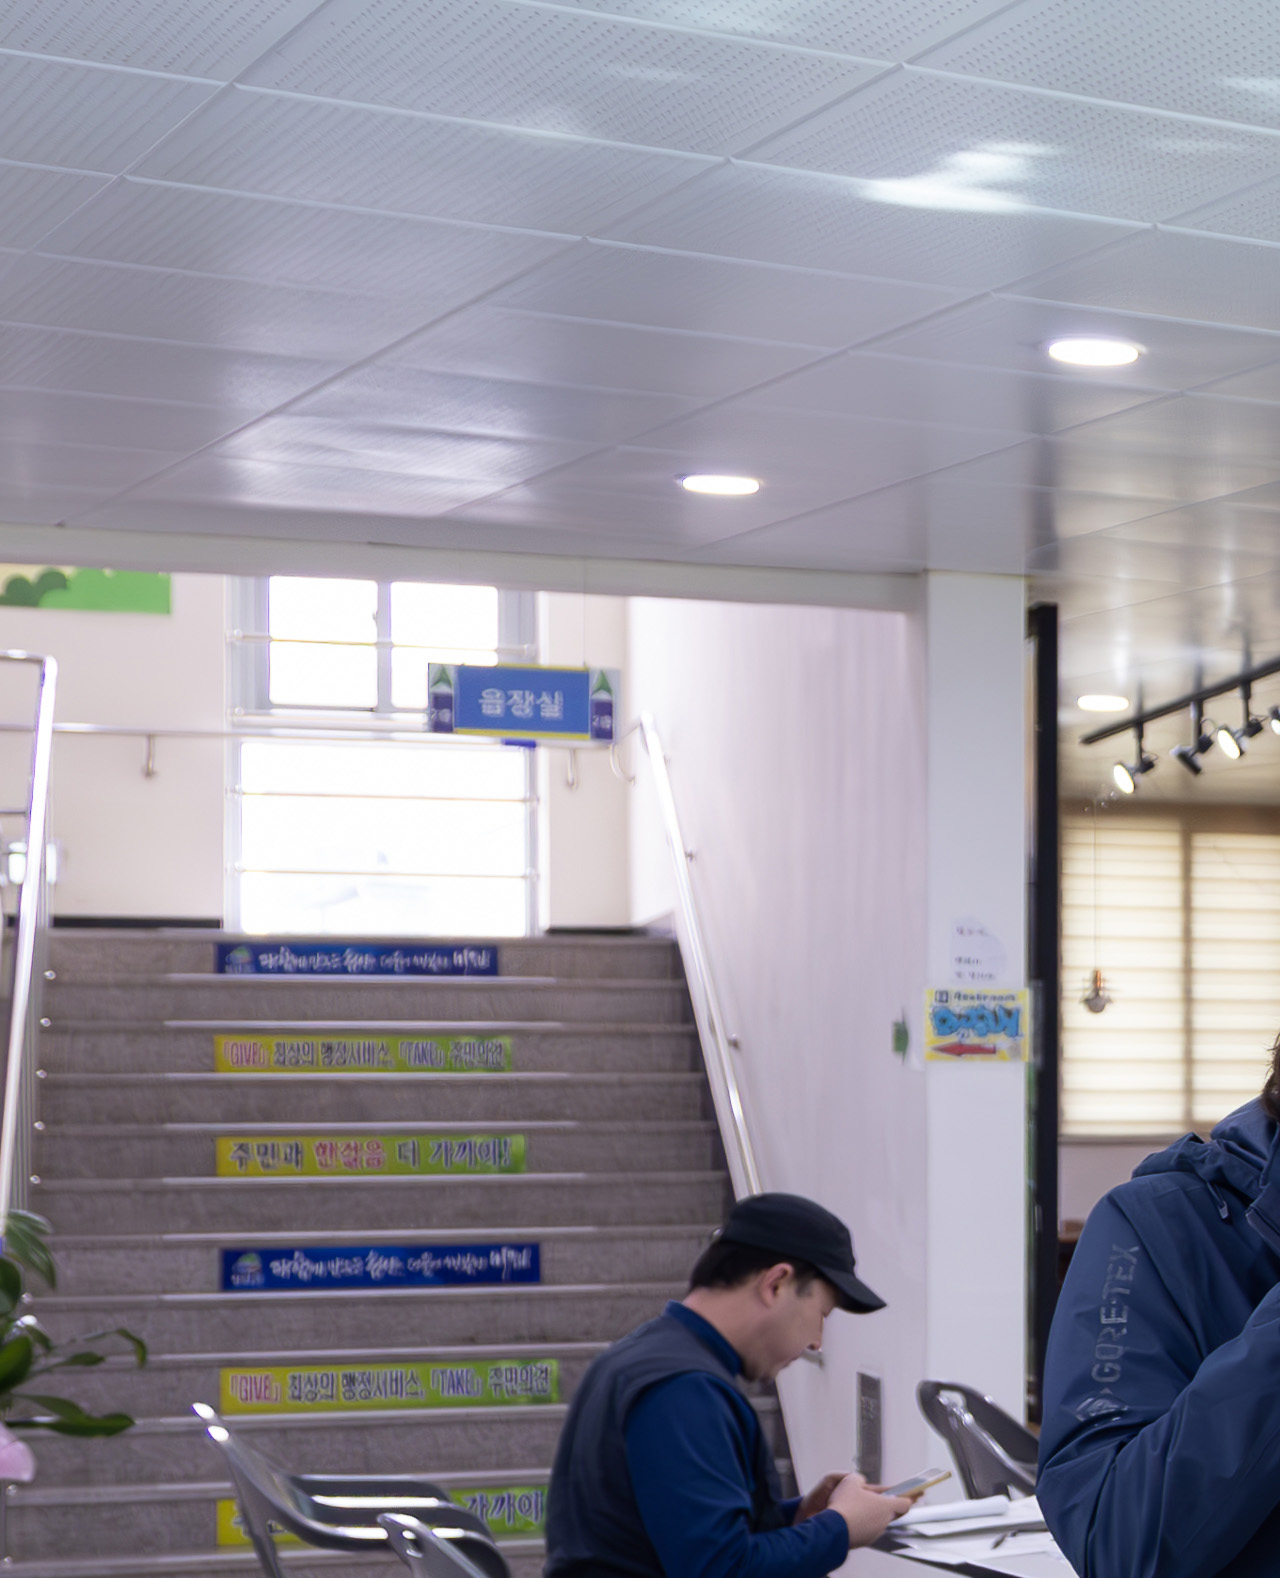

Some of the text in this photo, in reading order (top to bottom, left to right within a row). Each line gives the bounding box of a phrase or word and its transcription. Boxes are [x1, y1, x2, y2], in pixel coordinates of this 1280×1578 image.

[478, 688, 564, 720] 읍장실
[230, 1141, 303, 1171] 주민과
[397, 1141, 419, 1168] 더
[1091, 1244, 1139, 1383] GORE-TEX
[465, 1492, 544, 1524] 가까이
